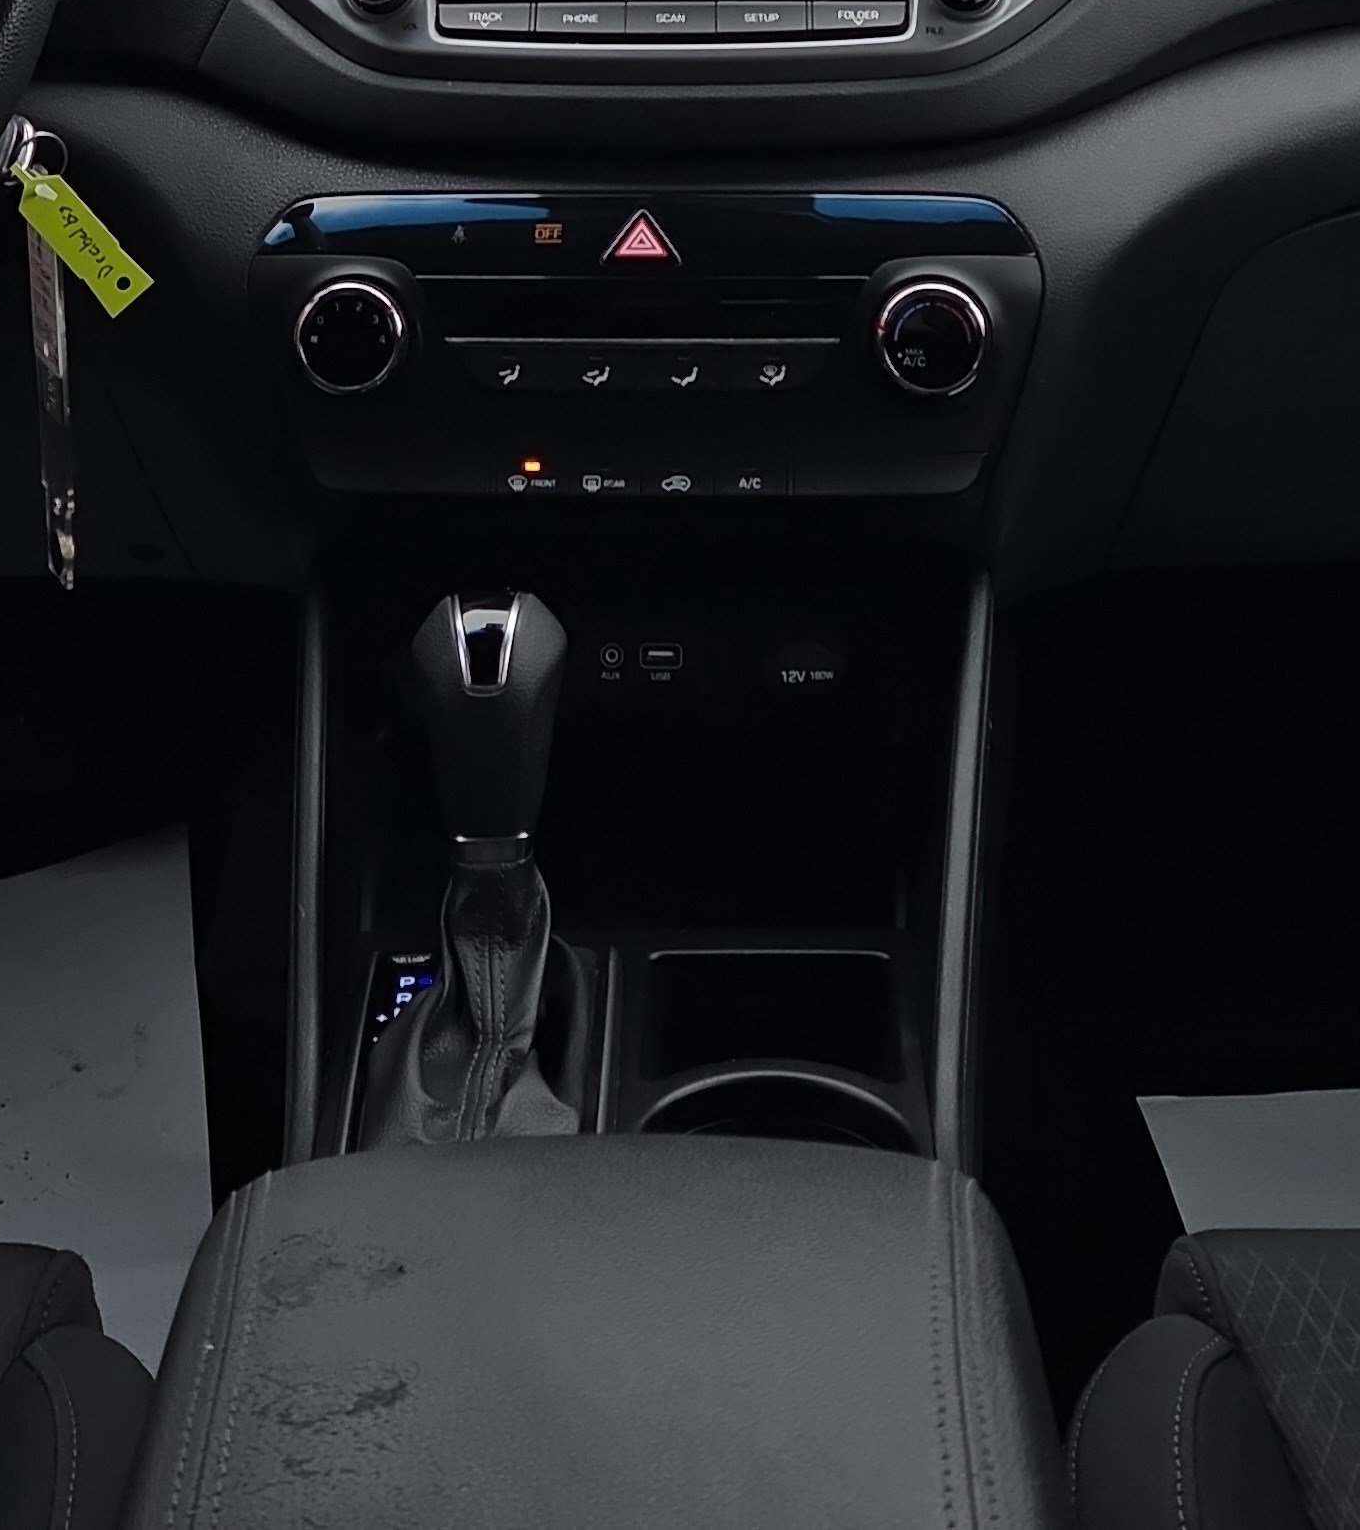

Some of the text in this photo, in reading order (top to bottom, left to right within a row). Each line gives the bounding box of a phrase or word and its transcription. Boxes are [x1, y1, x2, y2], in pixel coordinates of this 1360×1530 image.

[468, 11, 503, 22] TRACK
[562, 13, 599, 24] PHONE
[655, 13, 686, 24] SCAN
[744, 12, 780, 24] SETUP
[837, 9, 879, 21] FOLDER
[534, 228, 563, 239] OFF
[902, 356, 927, 368] A/C
[531, 478, 557, 489] FRONT
[604, 478, 626, 489] REAR
[739, 477, 762, 490] A/C
[600, 671, 621, 681] AUX
[651, 672, 671, 682] USB
[781, 670, 806, 684] 12V
[400, 976, 416, 989] P
